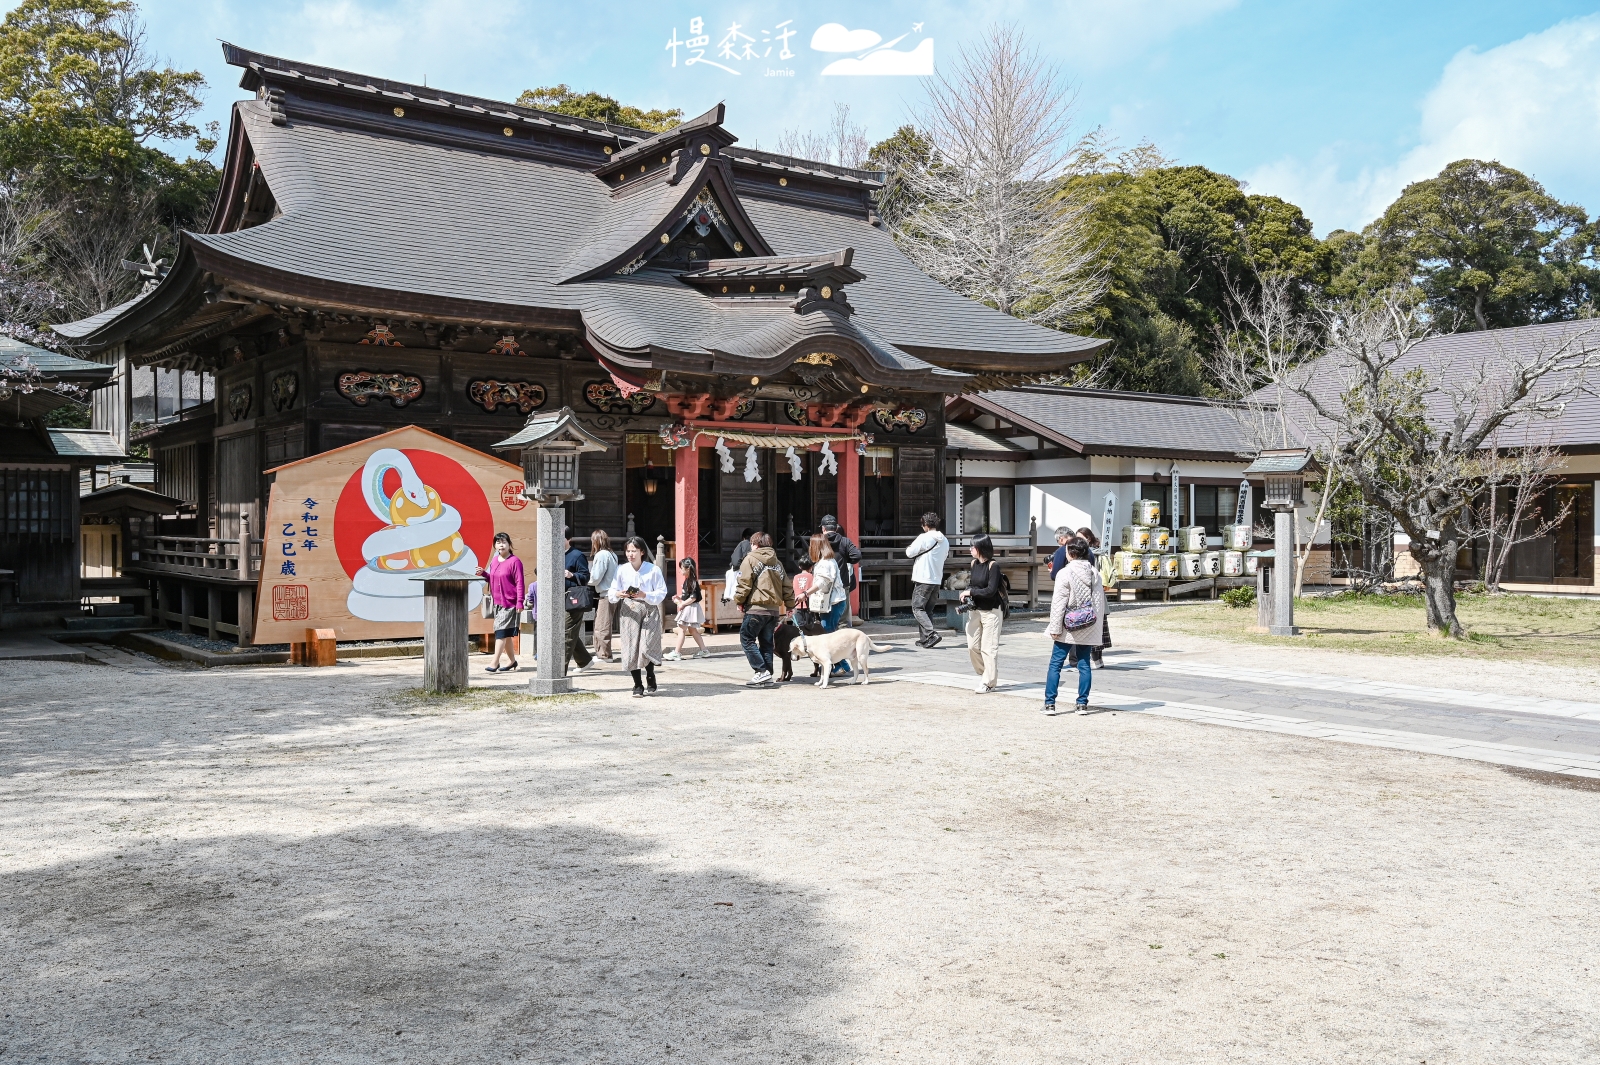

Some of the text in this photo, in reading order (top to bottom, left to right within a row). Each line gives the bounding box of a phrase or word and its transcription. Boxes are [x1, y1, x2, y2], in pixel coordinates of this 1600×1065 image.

[280, 523, 297, 576] 乙巳歳
[301, 497, 319, 551] 令和七年
